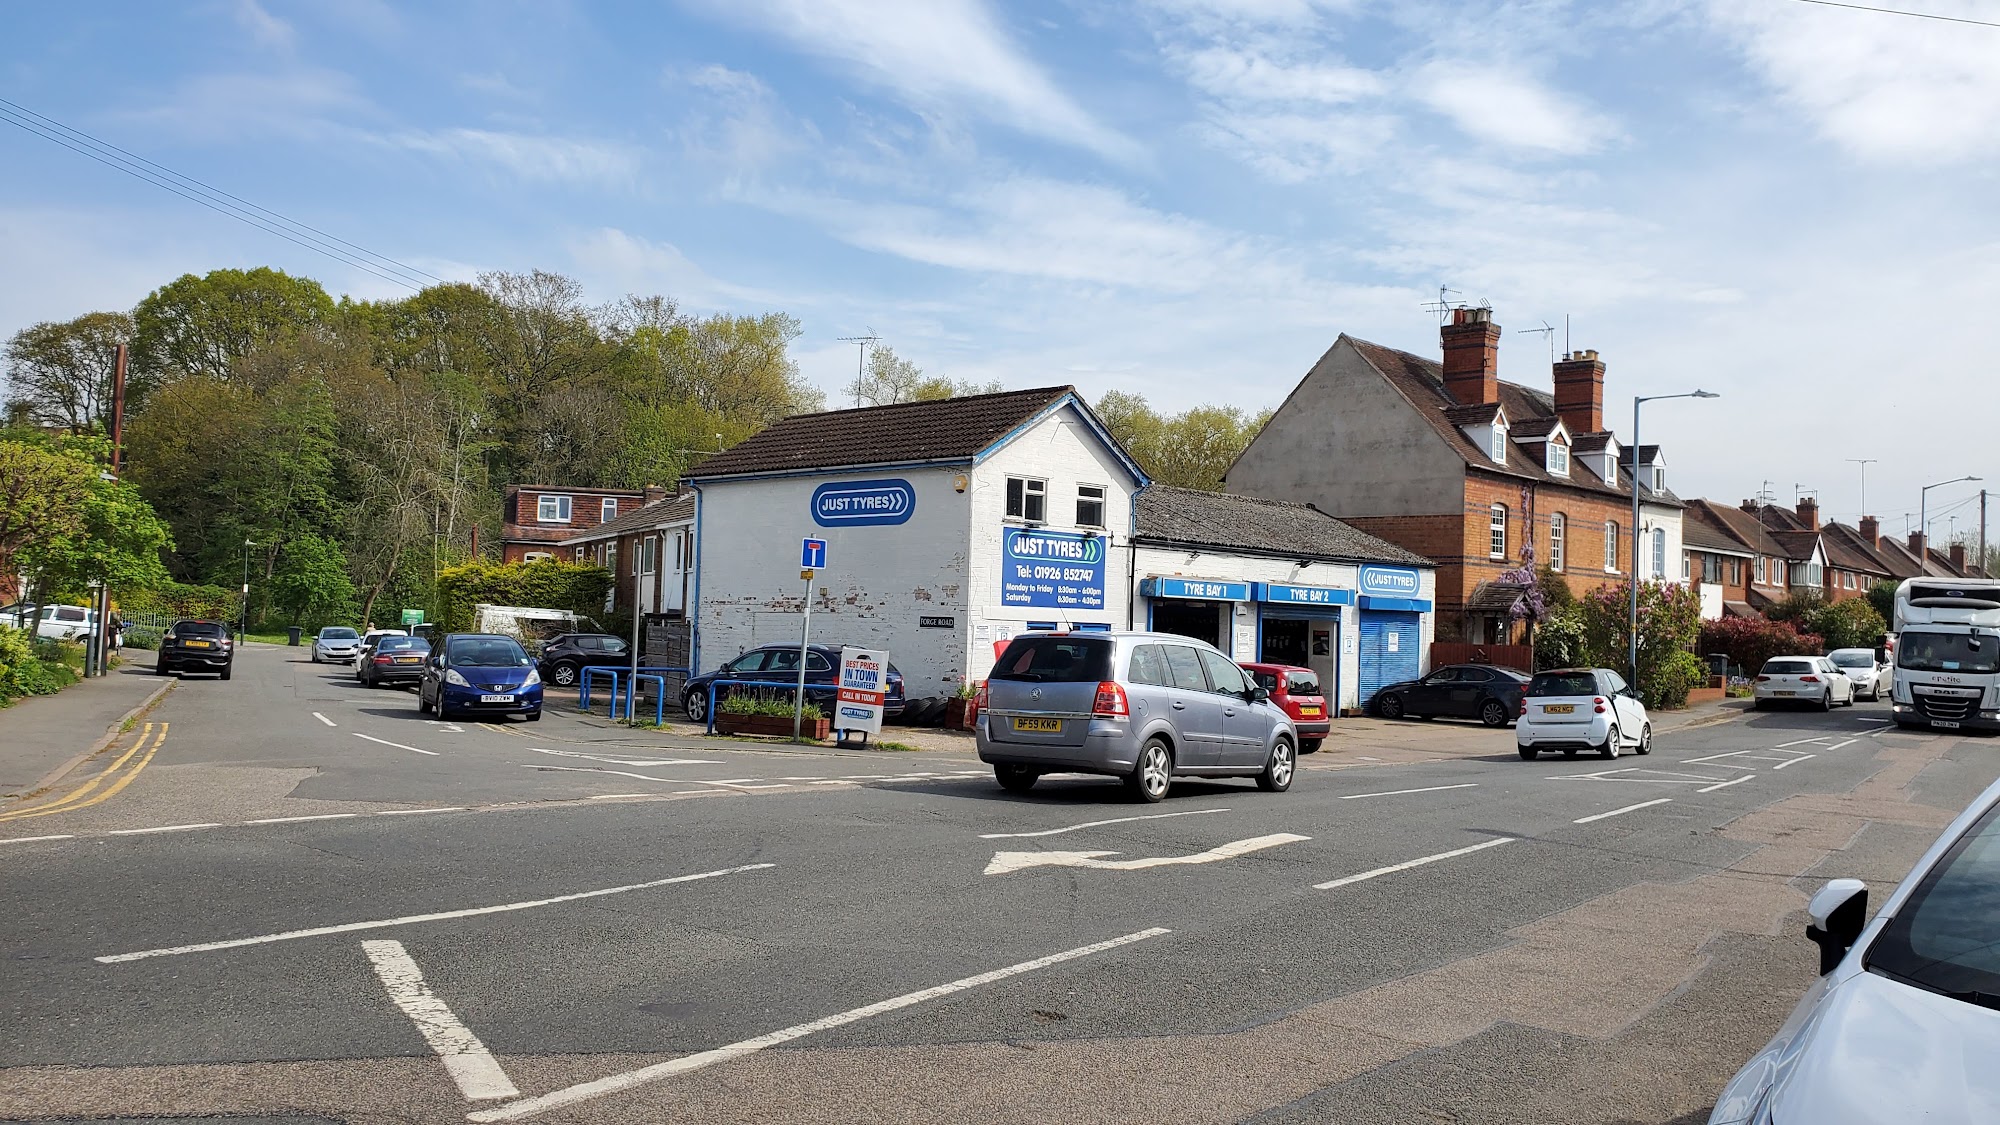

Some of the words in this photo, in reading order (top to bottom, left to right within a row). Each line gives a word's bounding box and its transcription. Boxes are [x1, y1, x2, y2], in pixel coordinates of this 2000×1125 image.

[822, 498, 851, 511] JUST
[852, 496, 890, 510] TYRES
[1014, 537, 1044, 555] JUST
[1046, 540, 1083, 558] TYRES
[1016, 565, 1032, 578] Tel:
[1034, 566, 1061, 580] 01926
[1063, 568, 1094, 582] 852747
[1375, 574, 1392, 586] JUST
[1393, 575, 1414, 587] TYRES
[1005, 583, 1029, 593] Monday
[1029, 584, 1036, 592] to
[1036, 584, 1054, 594] Friday
[1057, 585, 1077, 594] 8:30am
[1184, 582, 1204, 596] TYRE
[1206, 584, 1222, 597] BAY
[1223, 585, 1227, 597] 1
[1290, 588, 1308, 601] TYRE
[1309, 590, 1324, 601] BAY
[1324, 591, 1329, 602] 2
[1005, 593, 1031, 603] Saturday
[1057, 595, 1077, 604] 8:30am
[920, 618, 937, 626] FORGE
[937, 618, 954, 626] ROAD
[845, 660, 859, 668] BEST
[860, 661, 879, 671] PRICES
[844, 668, 853, 680] IN
[855, 669, 878, 682] TOWN
[842, 691, 854, 700] CALL
[854, 692, 861, 700] IN
[861, 693, 876, 702] TODAY
[1017, 718, 1039, 729] BF59
[1040, 719, 1058, 730] KKR
